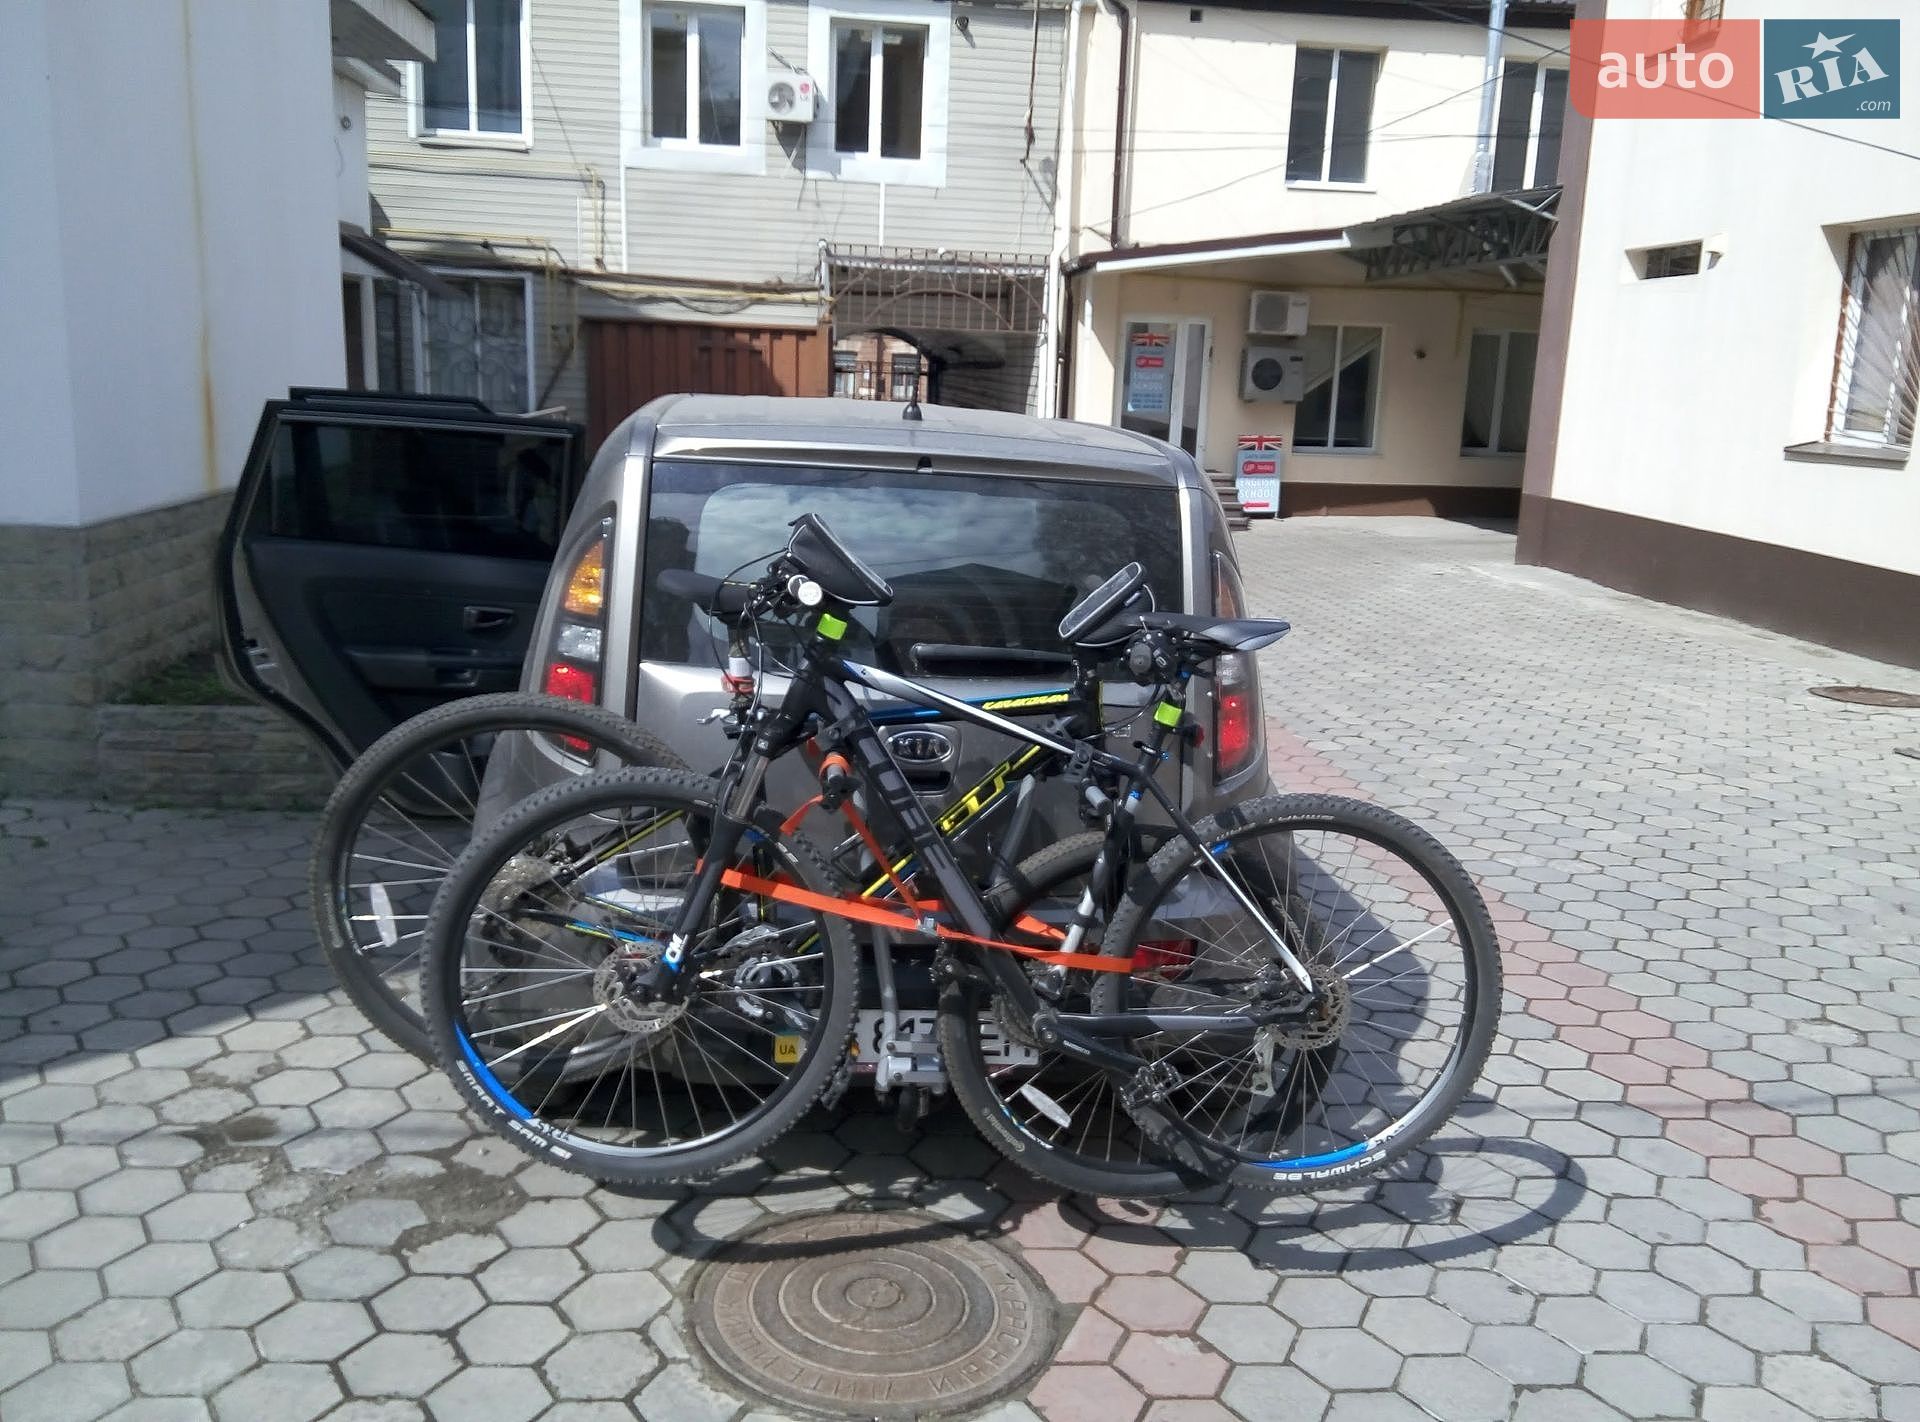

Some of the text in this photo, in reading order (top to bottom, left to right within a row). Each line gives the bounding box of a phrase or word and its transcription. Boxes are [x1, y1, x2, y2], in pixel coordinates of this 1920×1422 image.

[1239, 488, 1276, 498] SCHOOL
[779, 1044, 796, 1056] UA
[456, 1060, 548, 1148] SMART SAM
[1273, 1150, 1387, 1180] SCHWALBE
